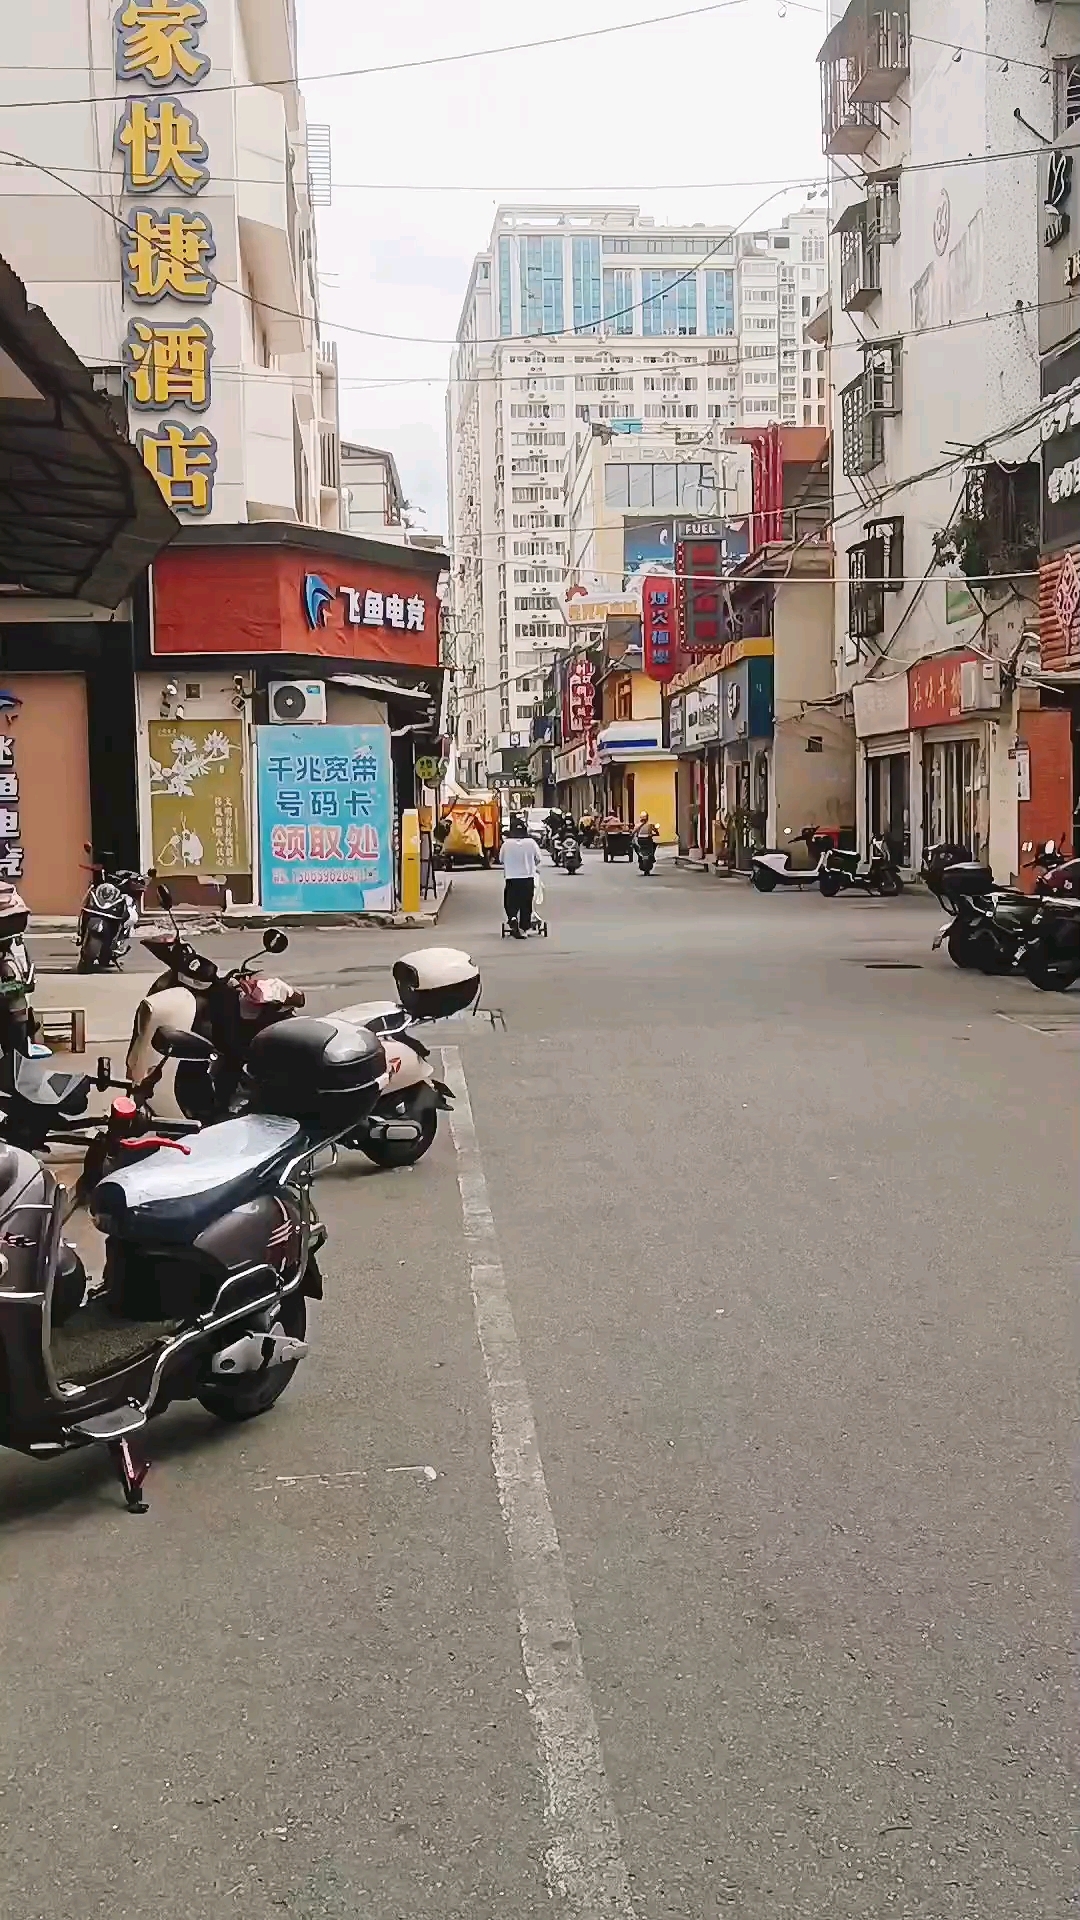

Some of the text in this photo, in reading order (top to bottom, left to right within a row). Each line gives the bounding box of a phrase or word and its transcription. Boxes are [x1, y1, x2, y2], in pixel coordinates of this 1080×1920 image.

[118, 0, 214, 511] 家快捷酒店
[685, 523, 717, 535] FUEL
[339, 586, 425, 631] 飞鱼电竞
[267, 755, 377, 782] 千兆宽带
[276, 789, 372, 816] 号码卡
[272, 824, 379, 860] 领取处
